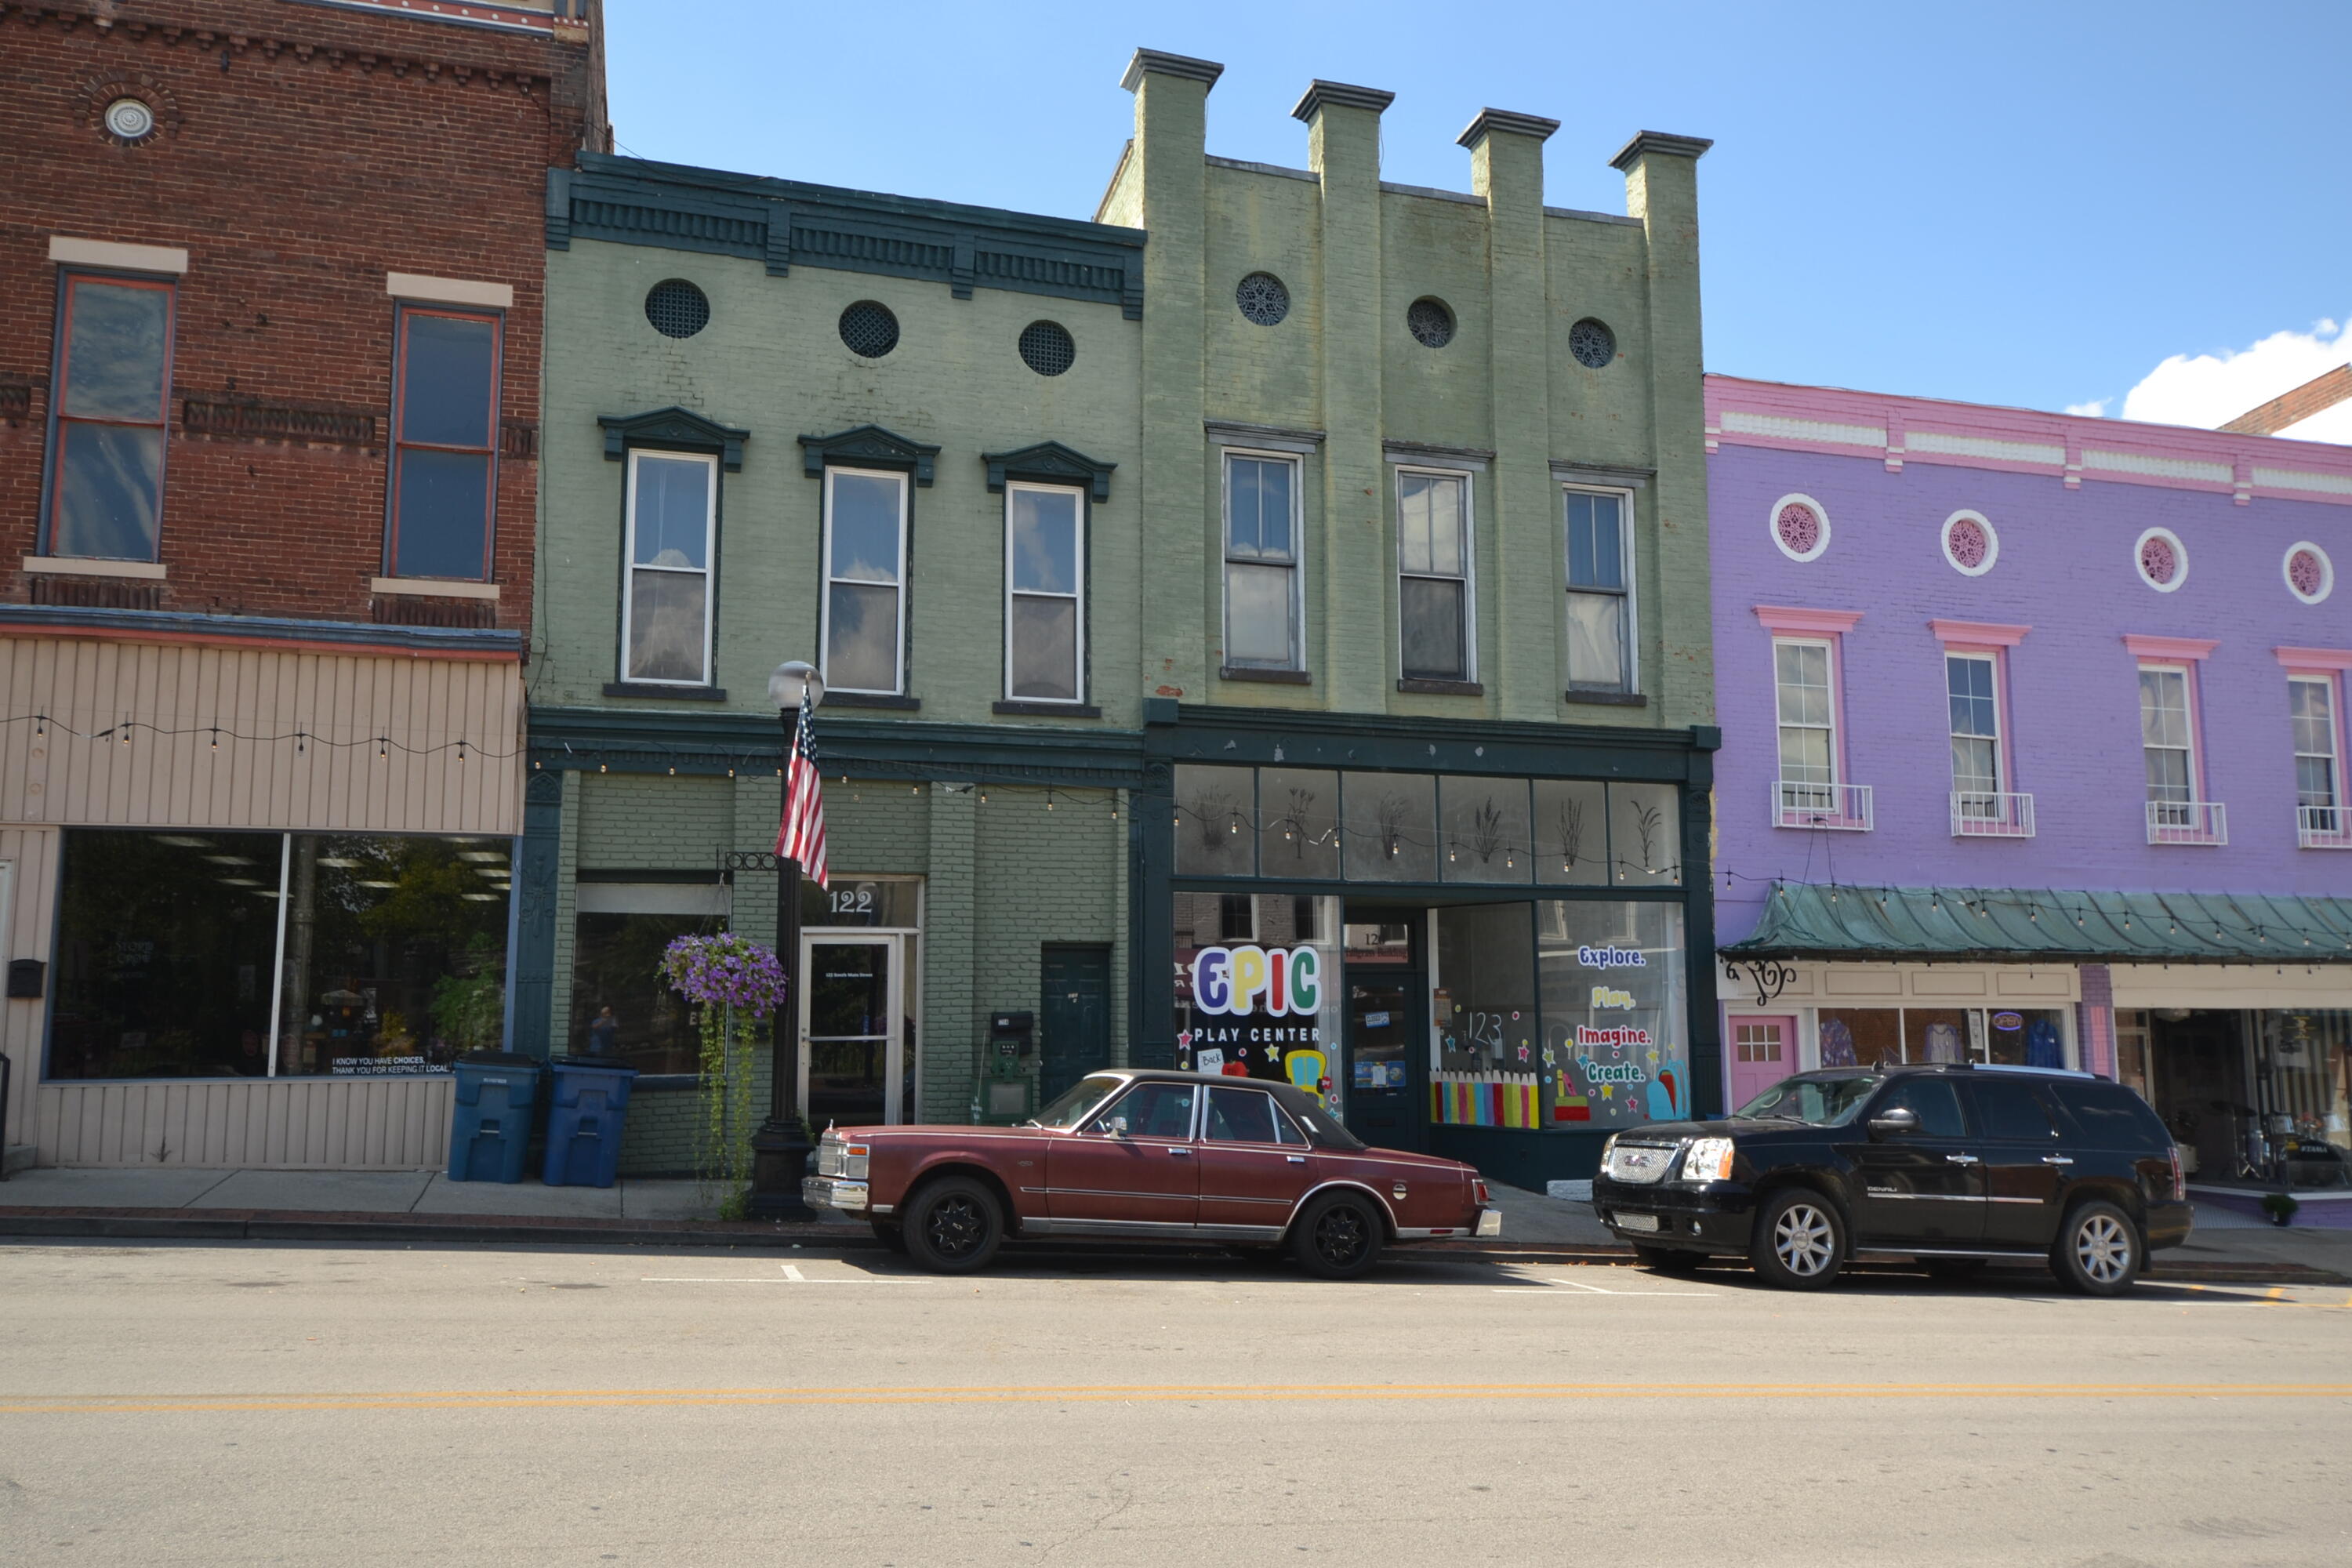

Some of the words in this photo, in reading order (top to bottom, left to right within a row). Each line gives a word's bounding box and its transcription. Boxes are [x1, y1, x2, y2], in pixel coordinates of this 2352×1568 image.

[829, 891, 872, 913] 122
[1578, 946, 1646, 970] Explore.
[1194, 947, 1319, 1014] EPIC
[1592, 986, 1636, 1010] Play.
[1194, 1028, 1240, 1042] PLAY
[1250, 1028, 1320, 1042] CENTER
[1469, 1011, 1502, 1045] 123
[1577, 1025, 1653, 1048] Imagine.
[1203, 1053, 1221, 1066] Back
[1587, 1062, 1646, 1083] Create.
